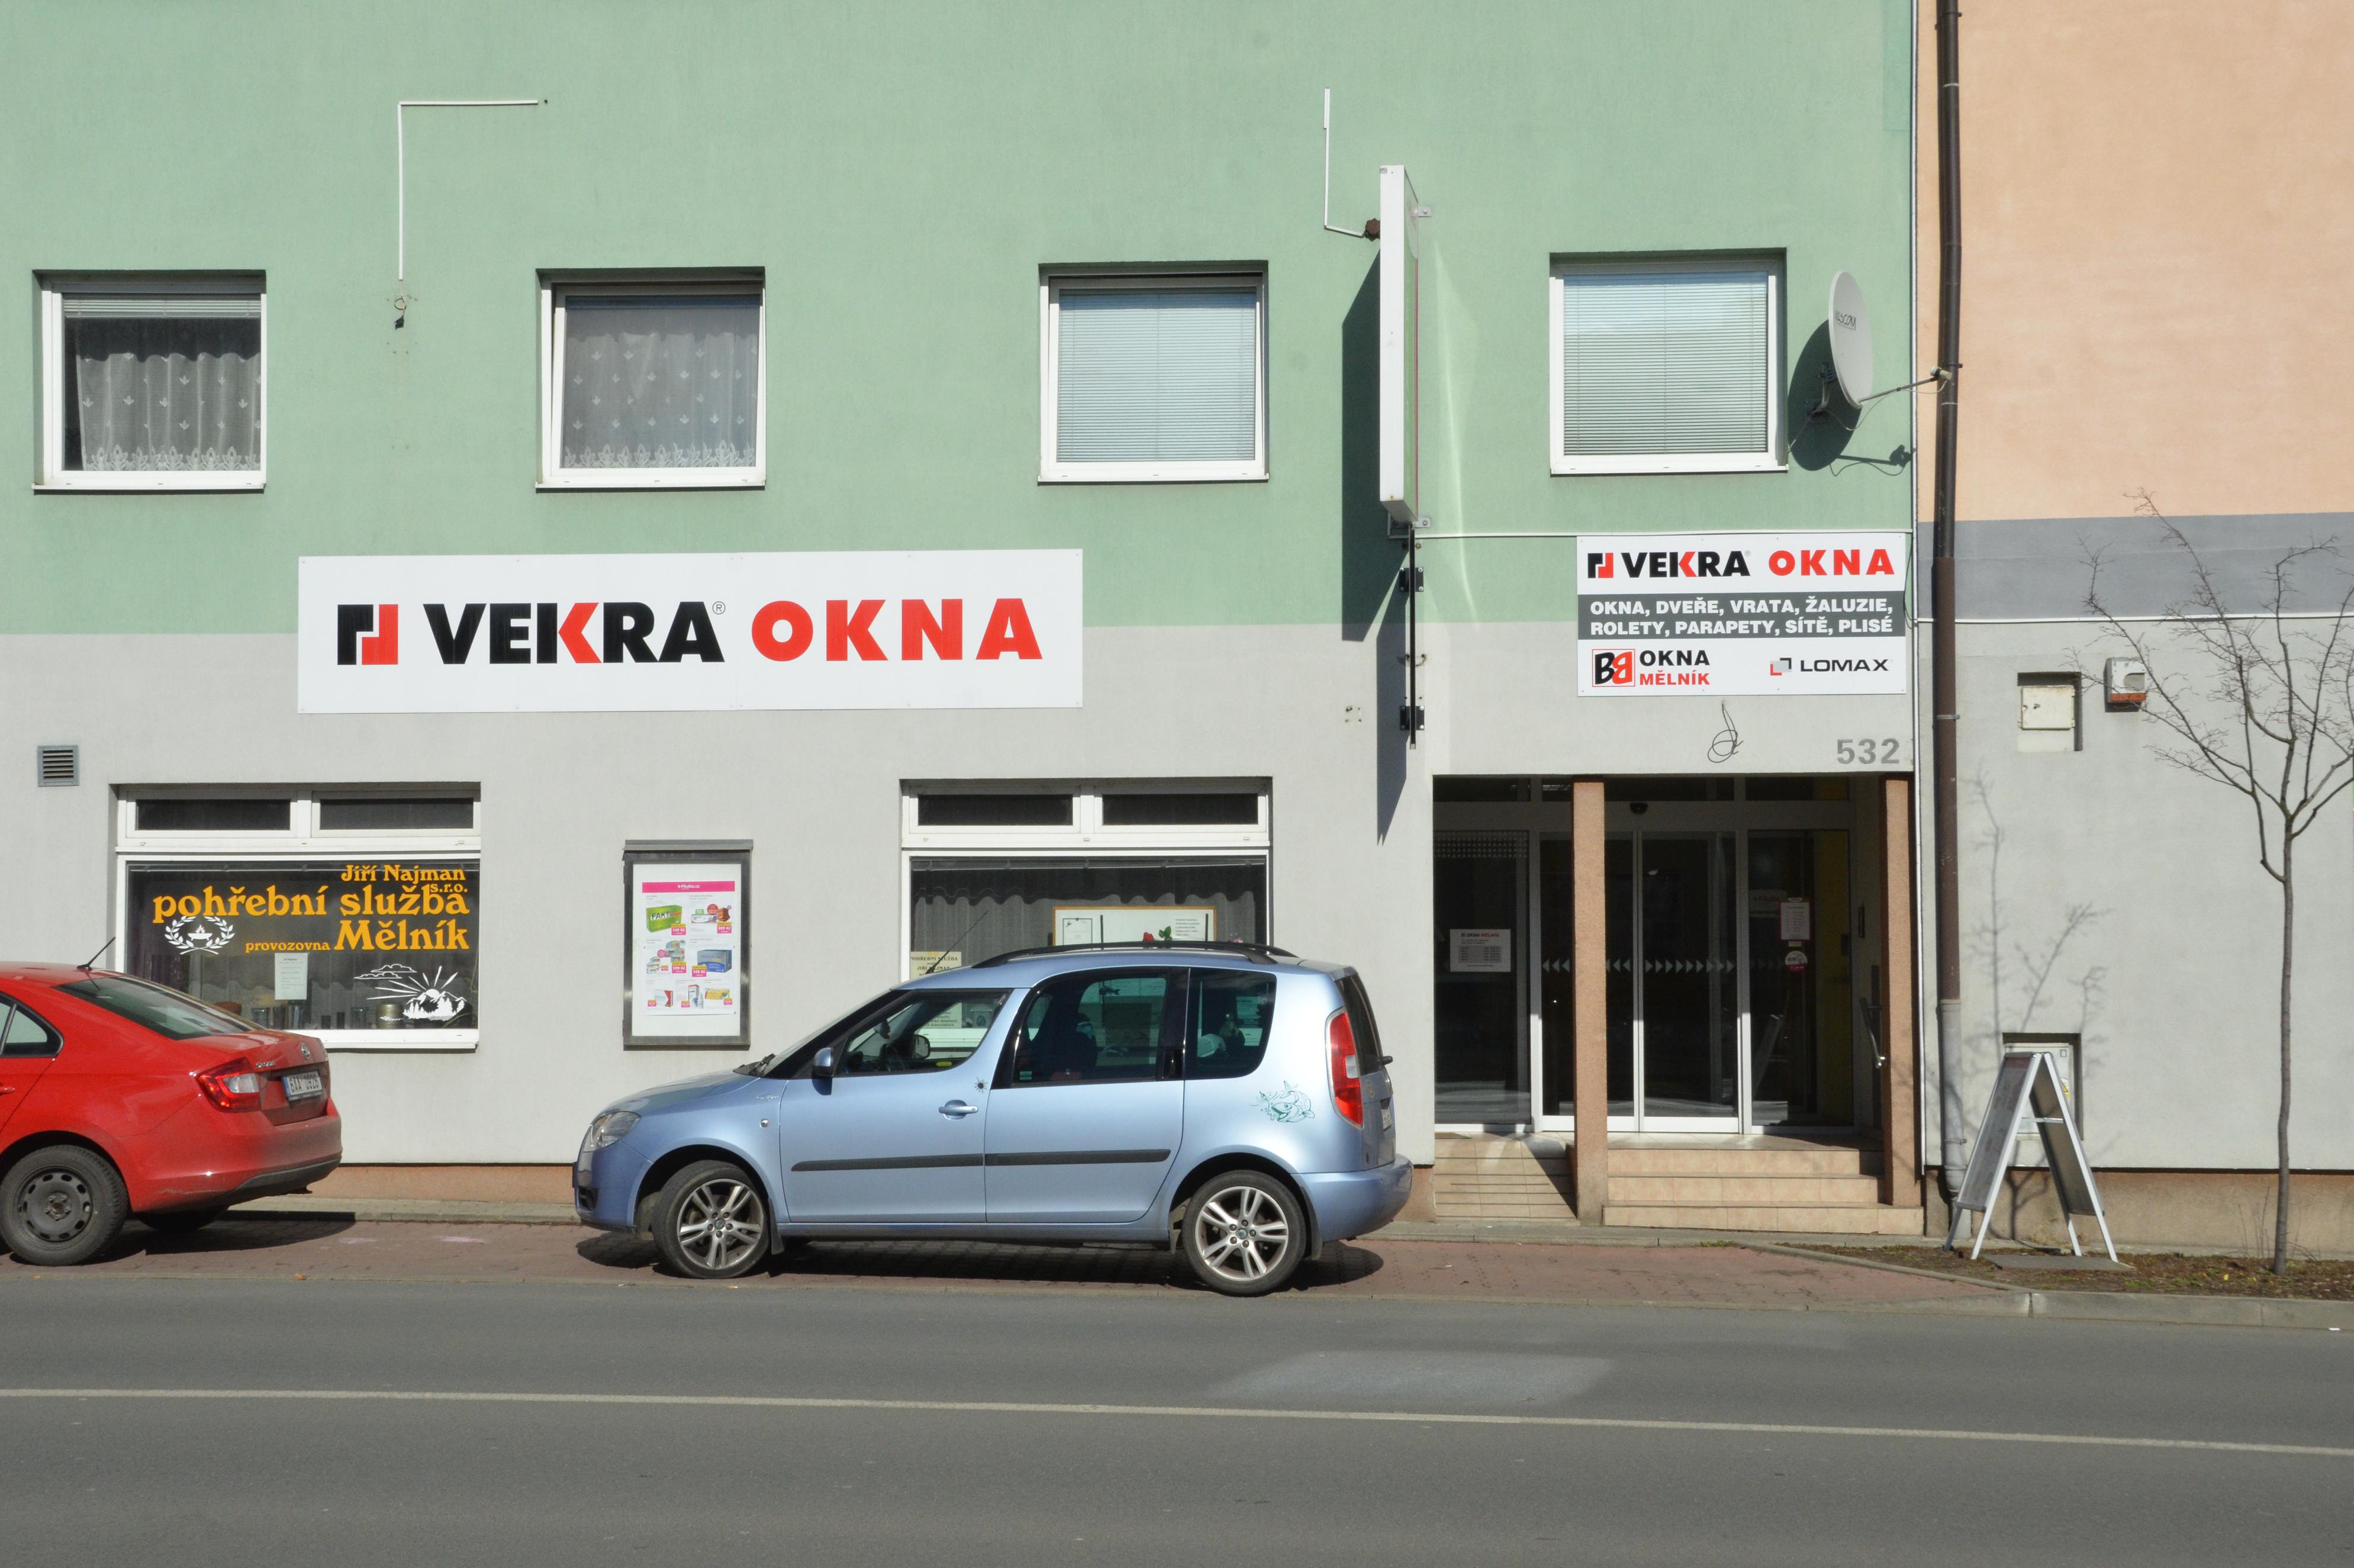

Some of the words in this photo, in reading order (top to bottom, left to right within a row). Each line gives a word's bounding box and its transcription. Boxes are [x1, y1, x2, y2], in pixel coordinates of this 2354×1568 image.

[1769, 549, 1894, 576] OKNA
[1590, 601, 1650, 617] OKNA,
[1656, 597, 1724, 616] DVEŘE,
[1730, 600, 1799, 615] VRATA,
[1806, 596, 1892, 614] ŽALUZIE,
[752, 598, 1042, 661] OKNA
[1591, 622, 1670, 637] ROLETY,
[1676, 620, 1779, 636] PARAPETY,
[1785, 616, 1833, 635] SÍTĚ,
[1839, 616, 1892, 632] PLISÉ
[1640, 650, 1710, 666] OKNA
[1801, 659, 1888, 672] LOMAX
[1640, 669, 1710, 685] MĚLNÍK
[1837, 739, 1899, 764] 532
[341, 864, 377, 881] Jiří
[384, 864, 466, 884] Najman
[430, 884, 468, 893] s.r.o.
[153, 884, 329, 924] pohřební
[340, 884, 470, 916] služba
[245, 941, 330, 954] provozovna
[334, 919, 469, 951] Mělník
